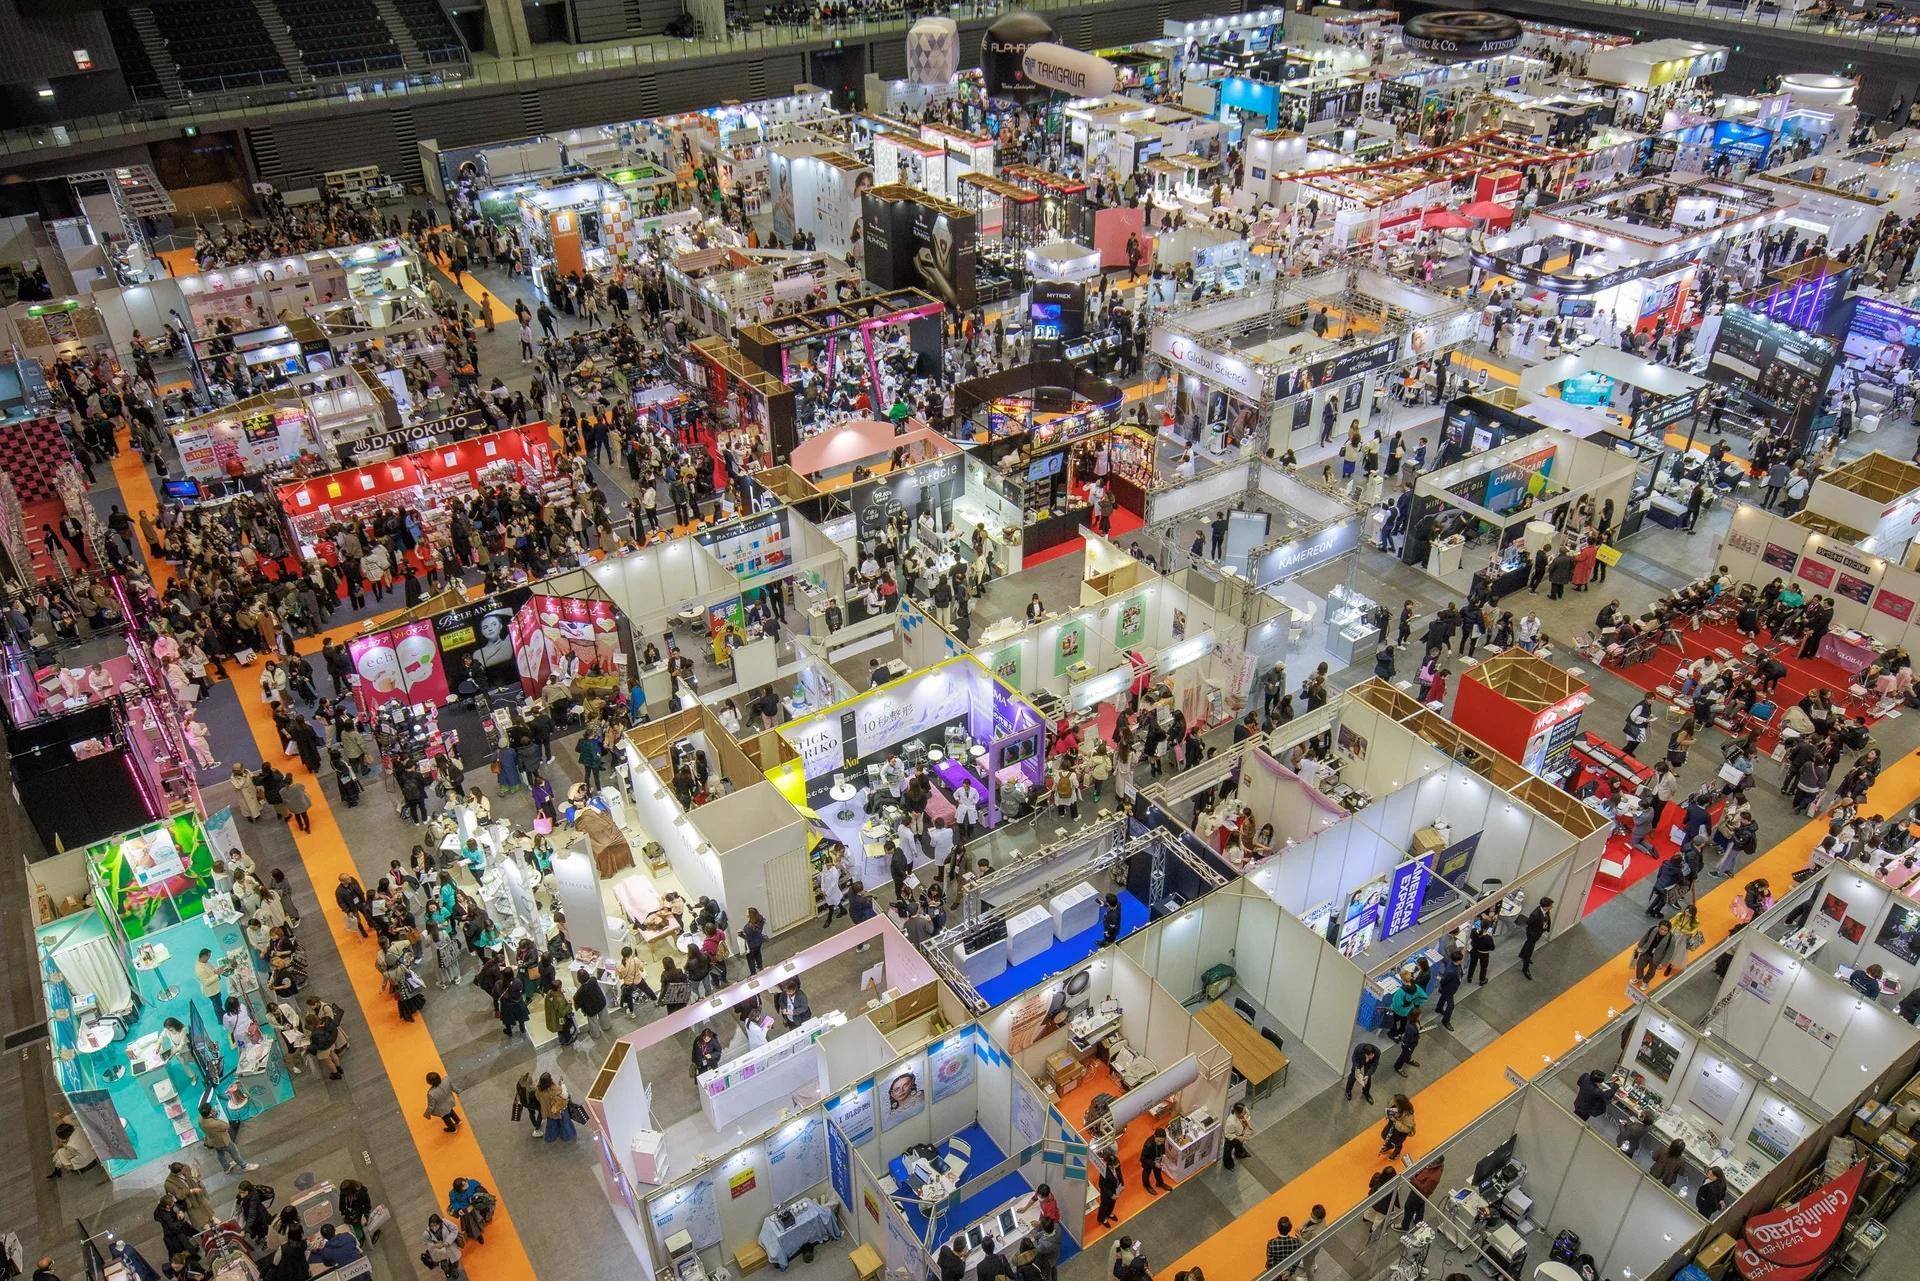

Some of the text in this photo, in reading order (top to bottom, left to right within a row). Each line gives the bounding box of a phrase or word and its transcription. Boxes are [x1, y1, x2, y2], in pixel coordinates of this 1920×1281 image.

[1038, 61, 1086, 88] TAKIGAWA
[1187, 351, 1213, 369] Global
[1216, 364, 1247, 386] Science
[1663, 399, 1695, 418] WINBACK
[372, 416, 468, 450] DAIYOKUJO
[1494, 472, 1516, 486] CYMA
[1279, 540, 1334, 569] KAMEREON
[1837, 650, 1863, 666] GLOBAL
[863, 704, 913, 734] 10秒整形
[1388, 874, 1410, 936] EXPRESS
[1400, 861, 1425, 931] AMERICAN
[343, 1264, 368, 1279] 1-A053
